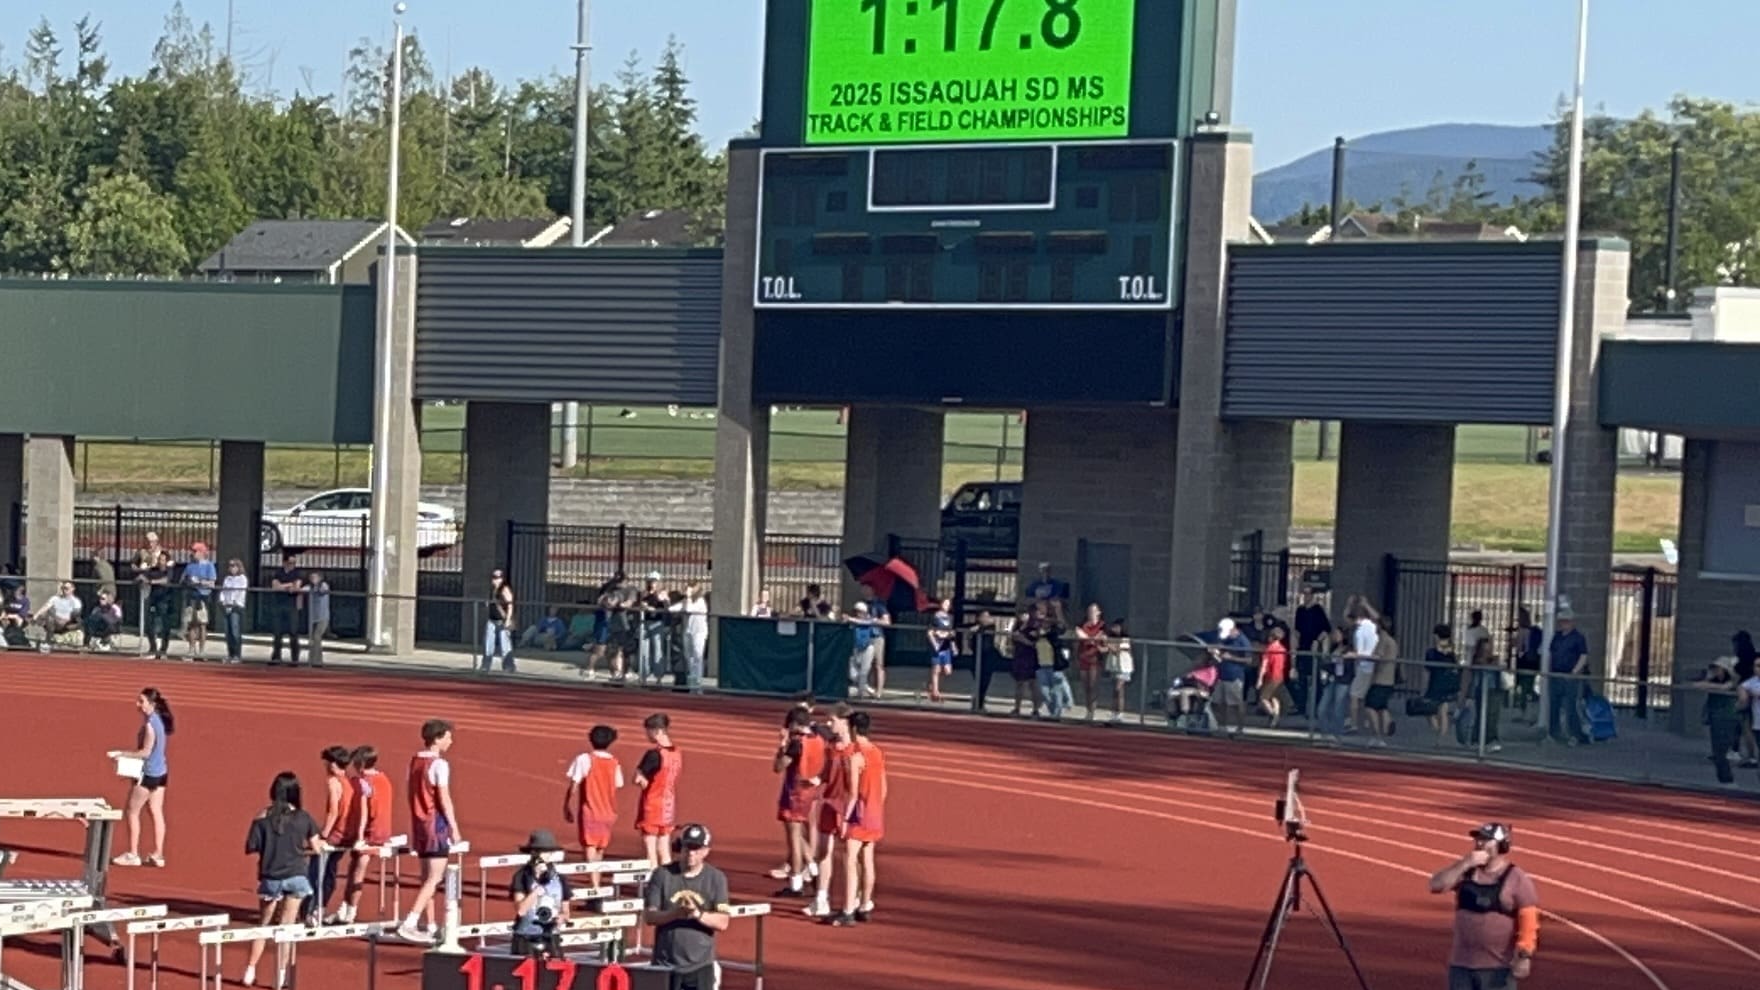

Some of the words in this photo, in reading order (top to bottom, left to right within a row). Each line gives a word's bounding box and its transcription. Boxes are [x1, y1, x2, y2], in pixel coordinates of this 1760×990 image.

[860, 0, 1081, 55] 1:17.8
[830, 82, 882, 107] 2025
[890, 78, 1017, 105] ISSAQUAH
[1025, 77, 1059, 101] SD
[1067, 75, 1104, 100] MS
[809, 112, 874, 134] TRACK
[879, 111, 891, 132] &
[898, 109, 952, 132] FIELD
[958, 105, 1125, 130] CHAMPIONSHIPS
[762, 276, 802, 299] T.O.L.
[1119, 276, 1162, 299] T.O.L.
